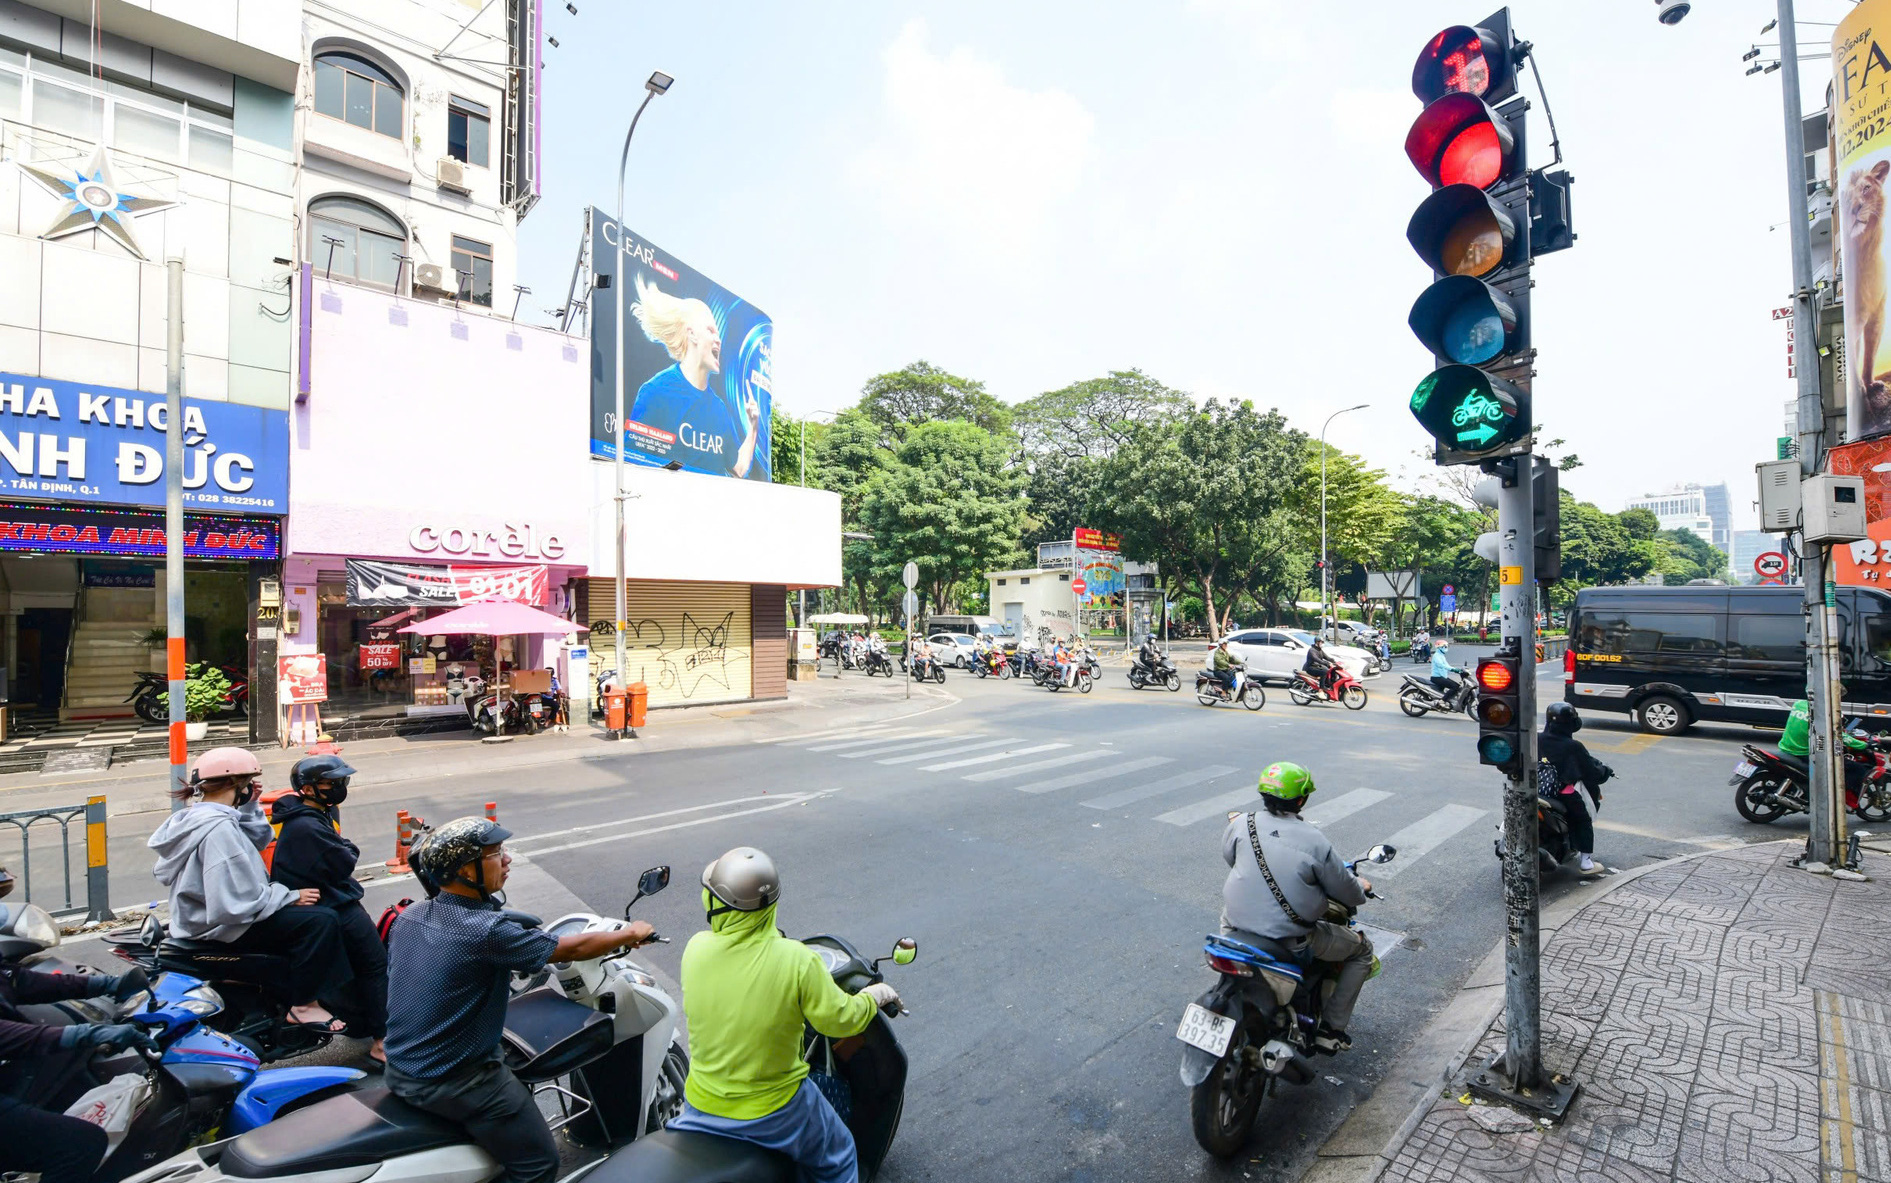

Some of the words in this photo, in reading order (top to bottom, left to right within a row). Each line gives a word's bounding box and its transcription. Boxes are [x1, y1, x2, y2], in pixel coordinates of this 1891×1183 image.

[1836, 40, 1891, 108] FA
[602, 221, 654, 268] CEAR
[655, 262, 675, 279] MEN
[78, 393, 208, 435] KHOA
[678, 422, 723, 454] CLEAR
[0, 431, 86, 480] NH
[115, 436, 255, 493] ĐỨC
[10, 478, 38, 490] TÂN
[80, 485, 100, 495] Q.1
[198, 493, 220, 503] 028
[222, 495, 275, 507] 38225416
[108, 526, 199, 548] MINH
[204, 530, 267, 550] ĐỨC
[409, 522, 566, 559] corèle
[405, 573, 451, 584] FLASH
[418, 586, 458, 598] SALE
[257, 607, 279, 619] 20
[368, 646, 392, 655] SALE
[367, 657, 381, 667] 50
[1251, 834, 1262, 852] FIND
[1256, 854, 1271, 880] MAGIC
[1269, 881, 1283, 902] YOUR
